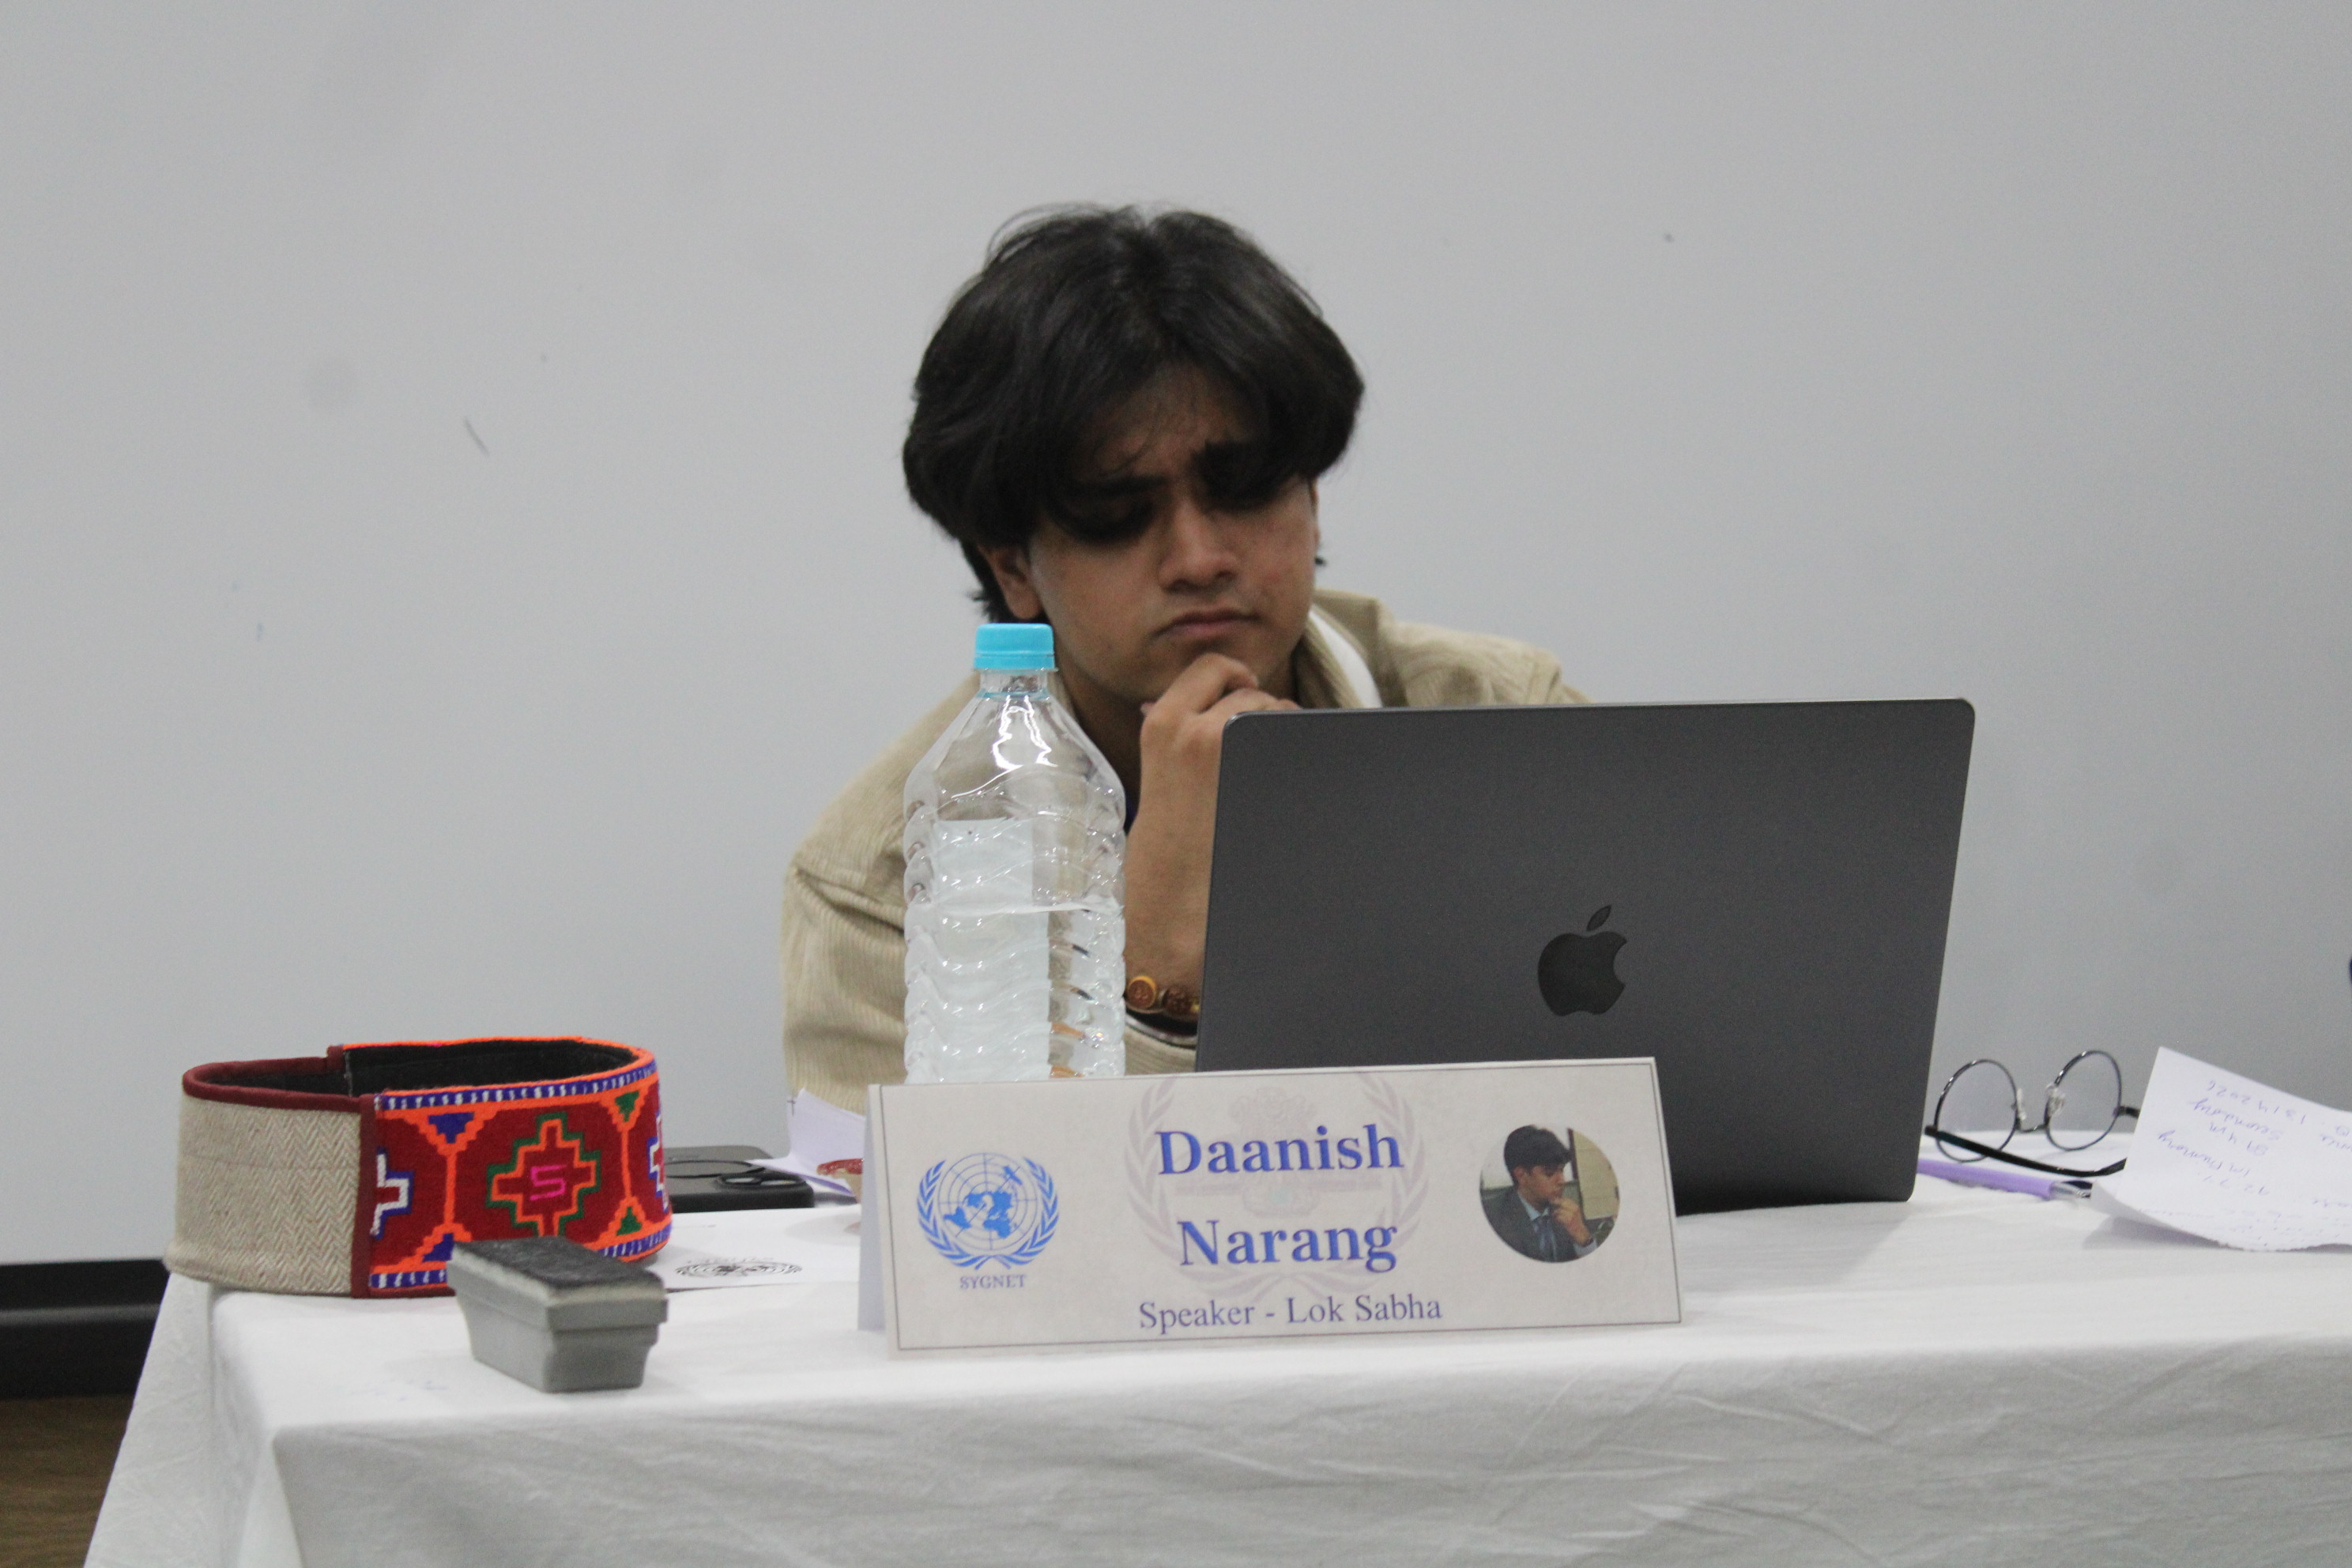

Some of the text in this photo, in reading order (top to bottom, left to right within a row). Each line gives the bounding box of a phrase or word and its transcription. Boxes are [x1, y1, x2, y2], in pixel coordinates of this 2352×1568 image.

[1154, 1123, 1404, 1176] Daanish
[1176, 1219, 1399, 1274] Narang
[959, 1274, 1026, 1290] SYGNET
[1138, 1298, 1256, 1336] Speaker
[1286, 1295, 1345, 1324] Lok
[1354, 1291, 1442, 1322] Sabha
